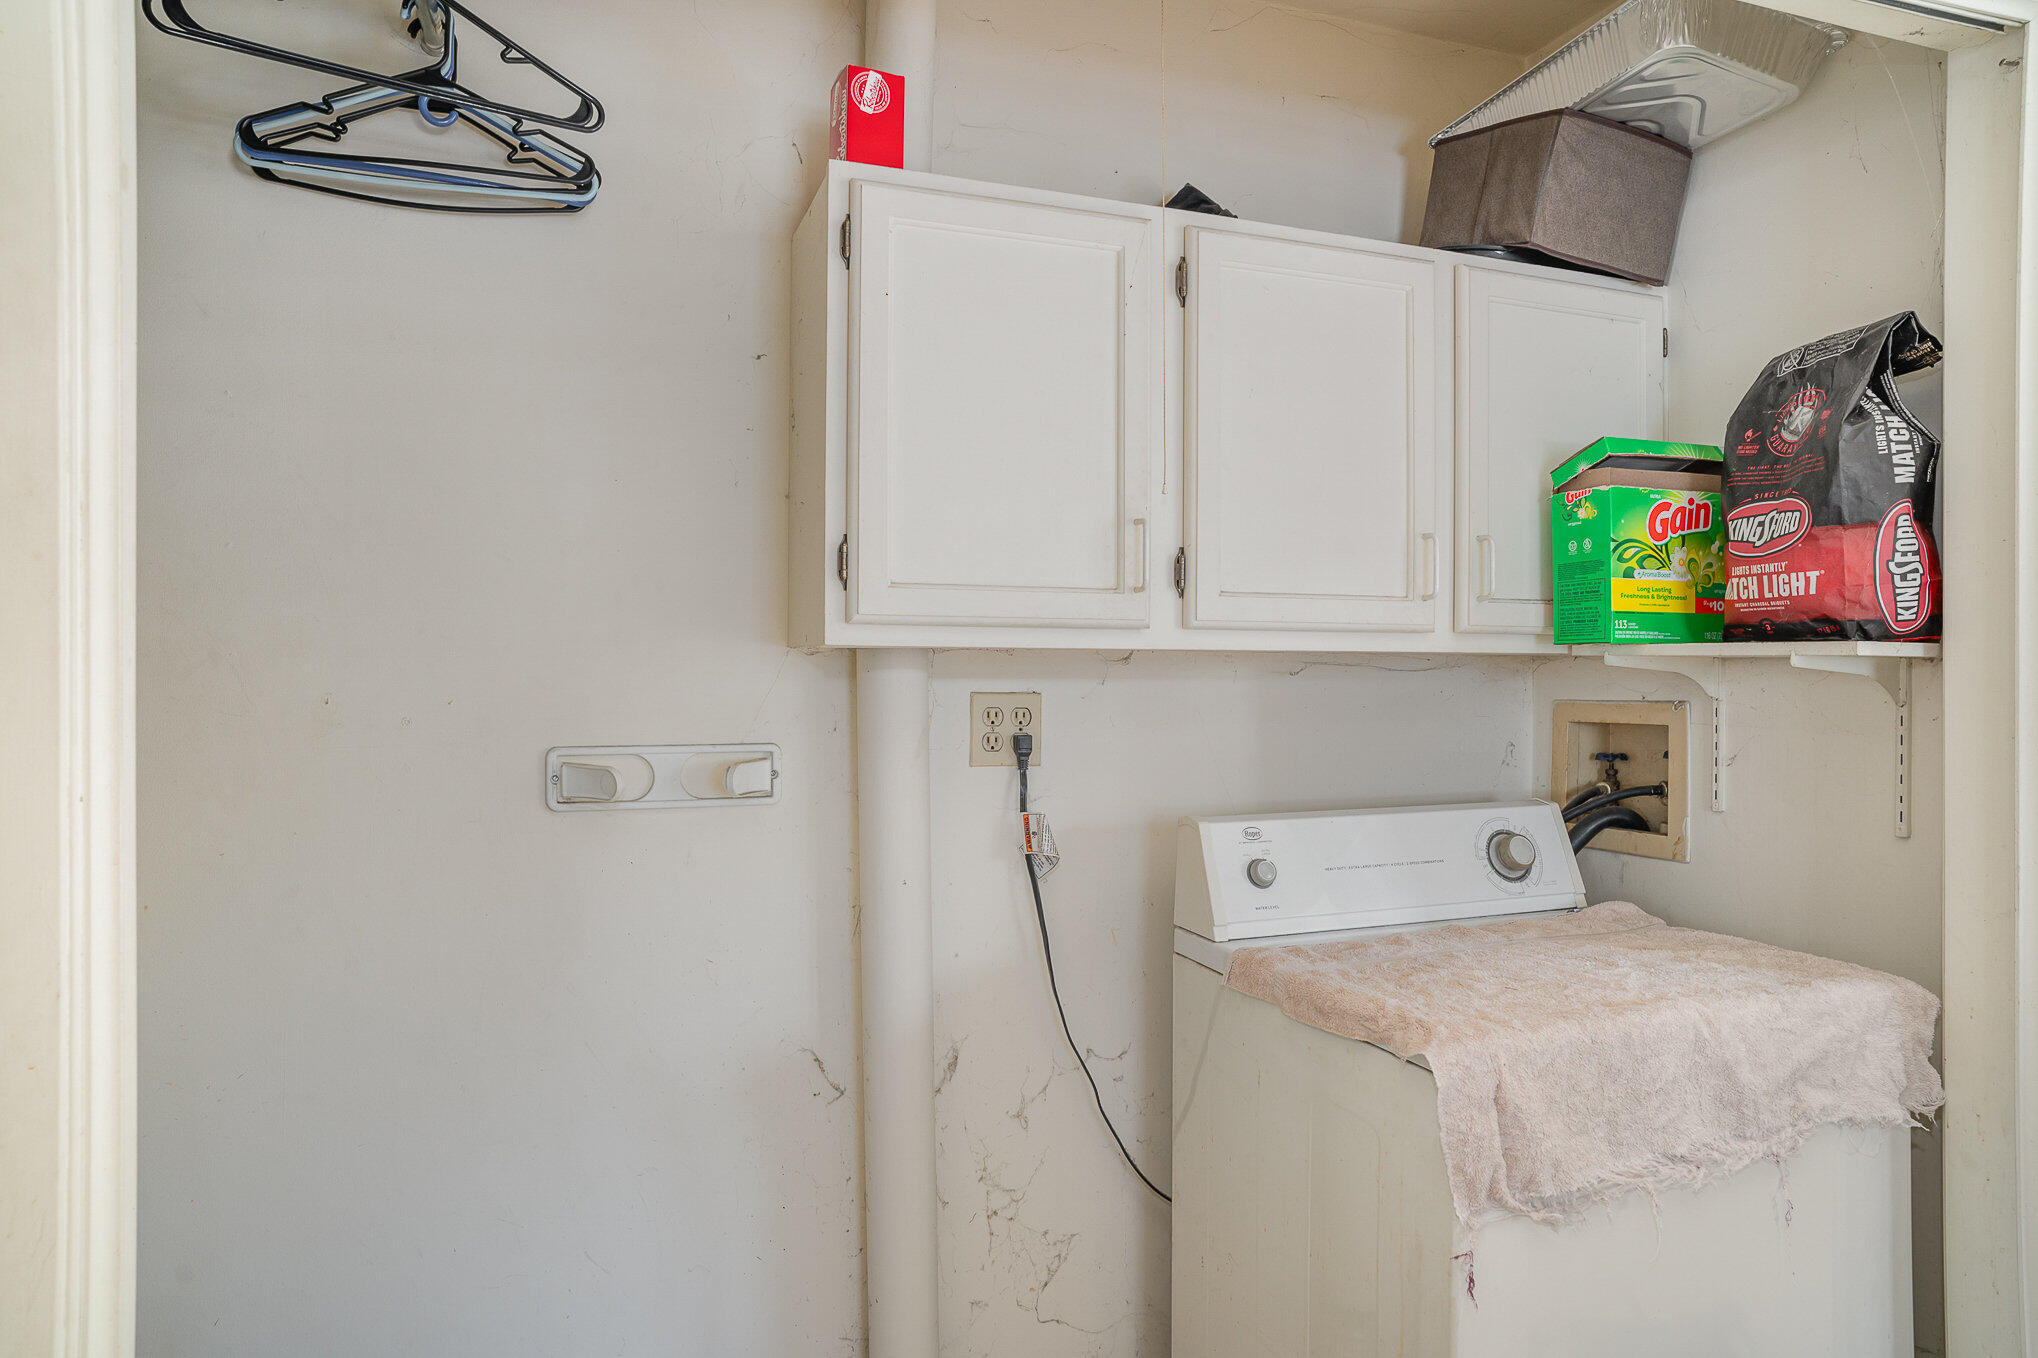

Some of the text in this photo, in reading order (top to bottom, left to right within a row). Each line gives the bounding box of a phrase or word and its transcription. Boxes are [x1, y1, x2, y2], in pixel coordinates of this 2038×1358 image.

[1860, 395, 1885, 424] INSTANT
[1875, 425, 1889, 454] LIGHTS
[1884, 415, 1916, 483] MATCH
[1754, 490, 1780, 500] SINCE
[1646, 496, 1712, 545] Gain
[1728, 508, 1801, 547] KINGSFORD
[1731, 564, 1750, 576] LIGHTS
[1887, 514, 1924, 622] KINGSFORD
[1620, 592, 1651, 600] Freshness
[1637, 586, 1672, 595] Long Lasting
[1725, 570, 1821, 601] ATCH LIGHT
[1614, 619, 1628, 629] 113
